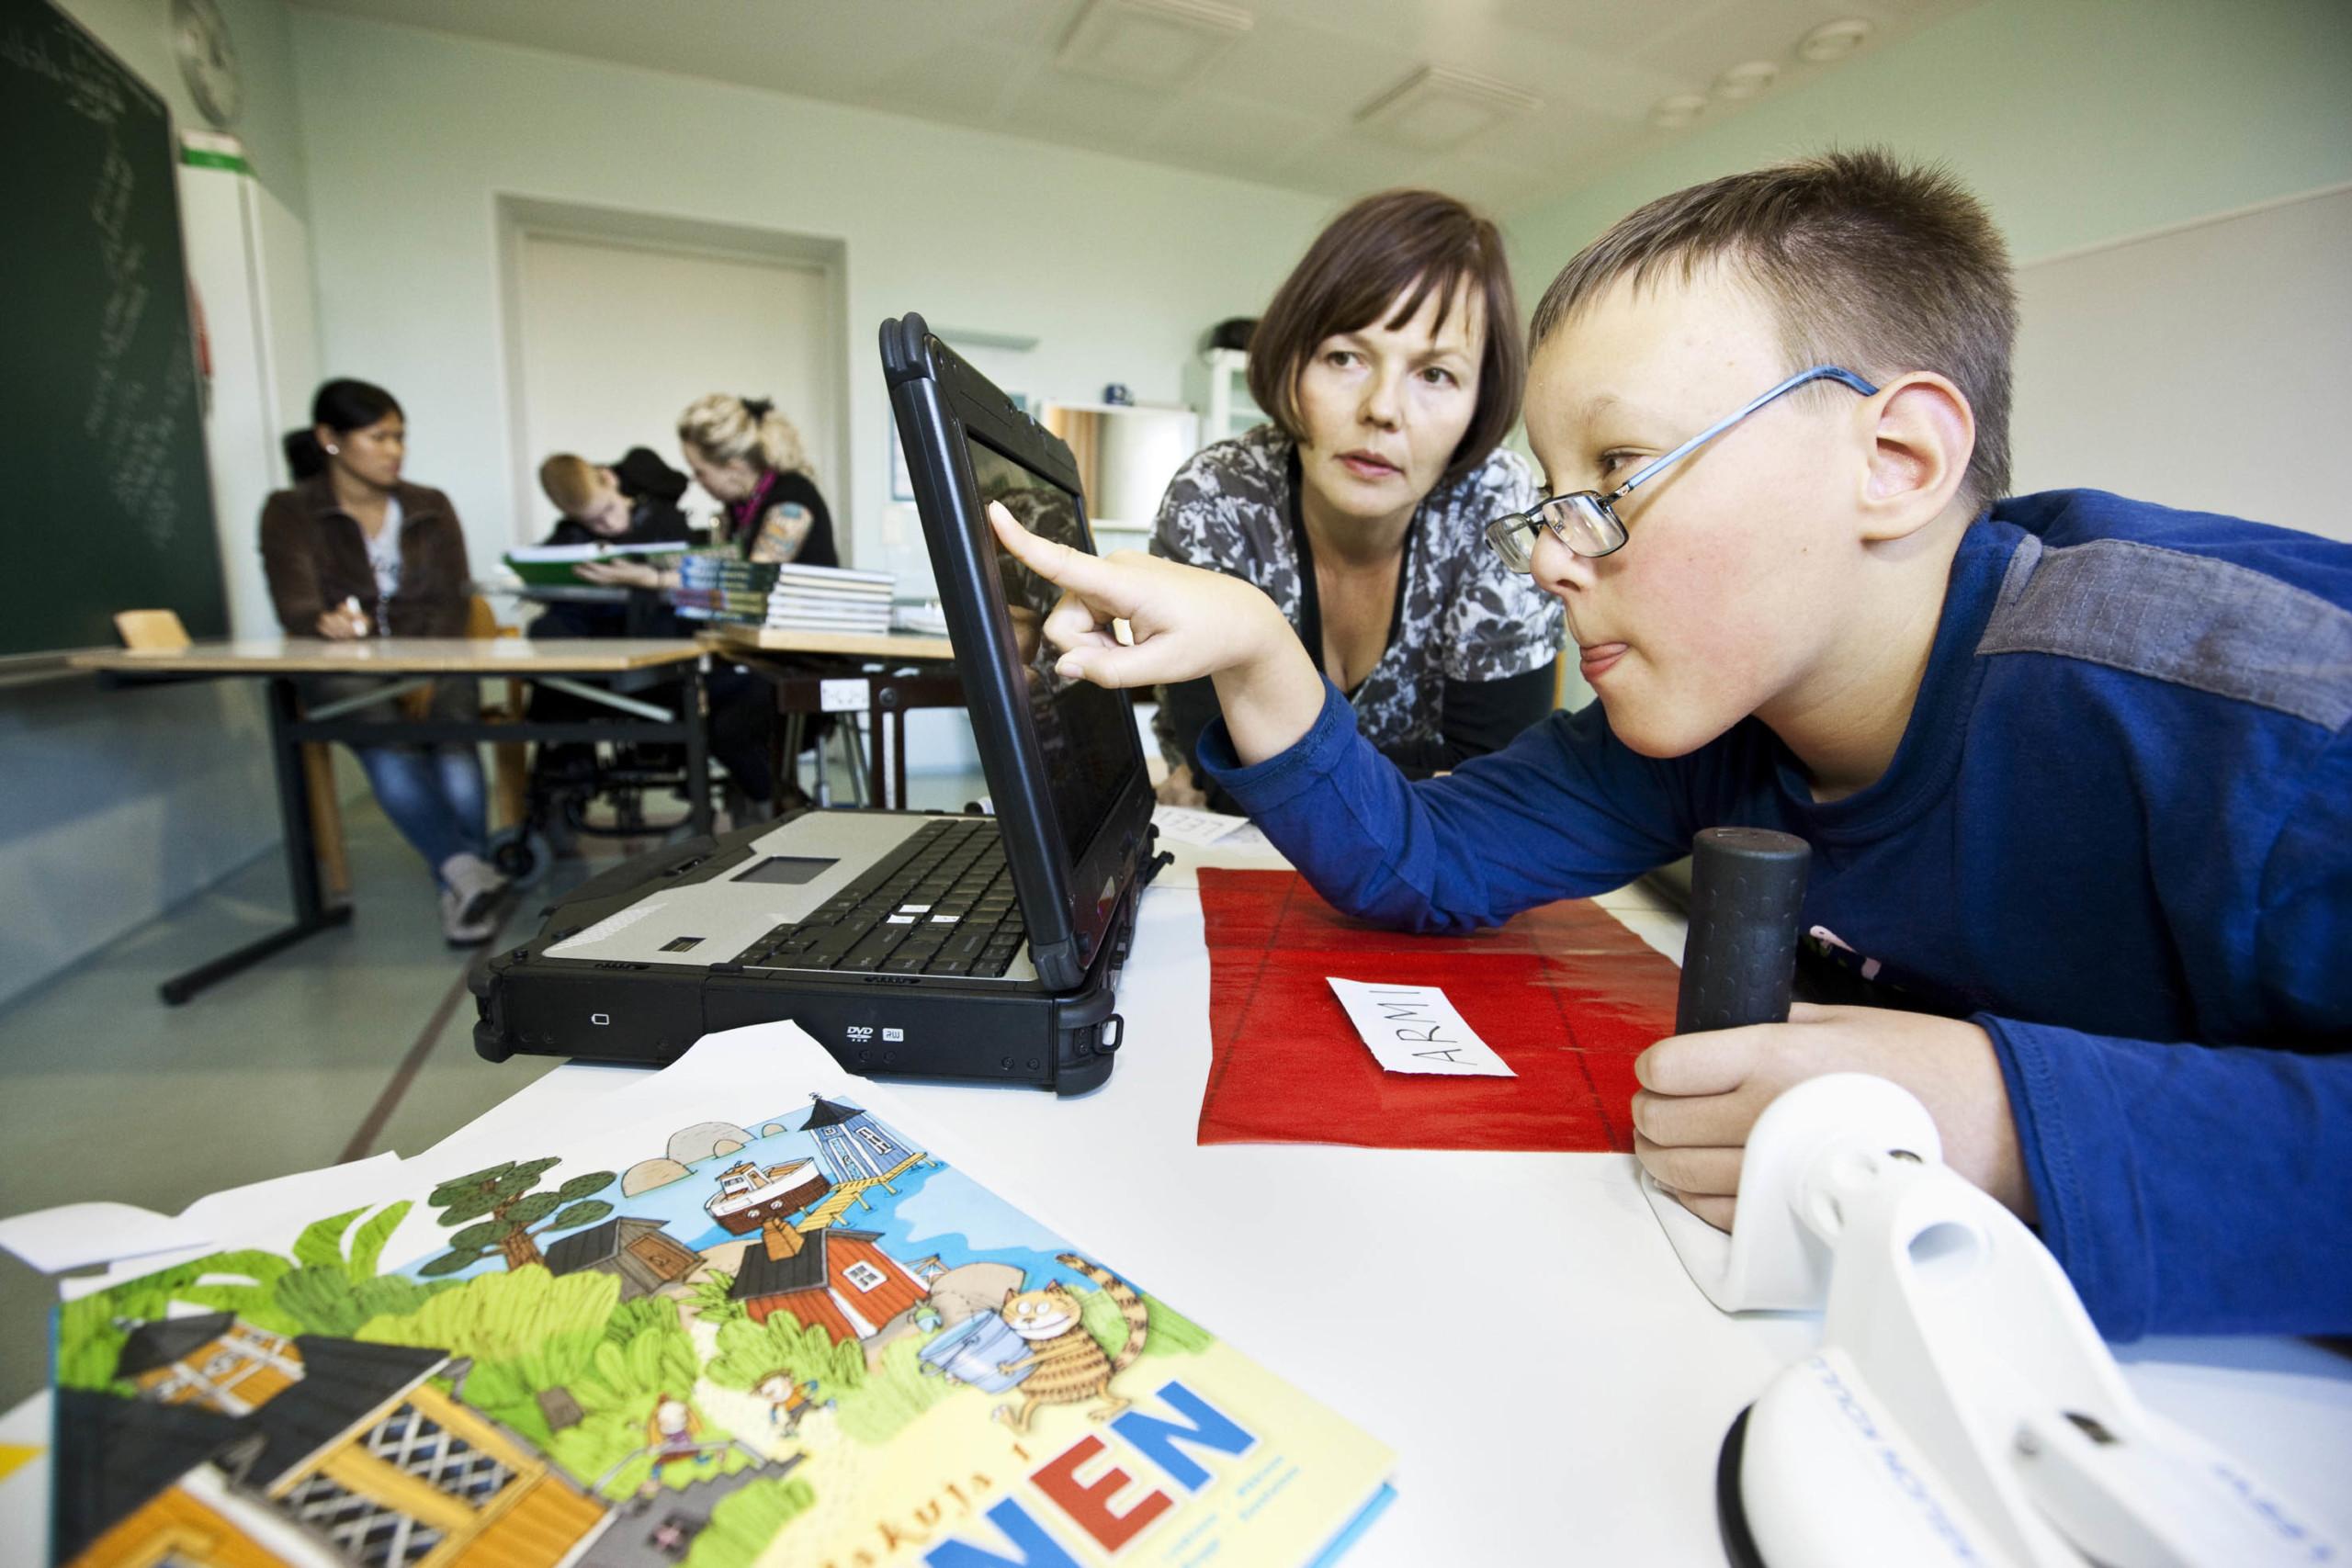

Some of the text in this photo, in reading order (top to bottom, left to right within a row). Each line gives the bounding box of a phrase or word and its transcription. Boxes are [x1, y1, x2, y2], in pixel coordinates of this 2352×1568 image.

[846, 1026, 874, 1035] DVD
[1369, 989, 1477, 1066] ARMI
[885, 1030, 901, 1040] RW
